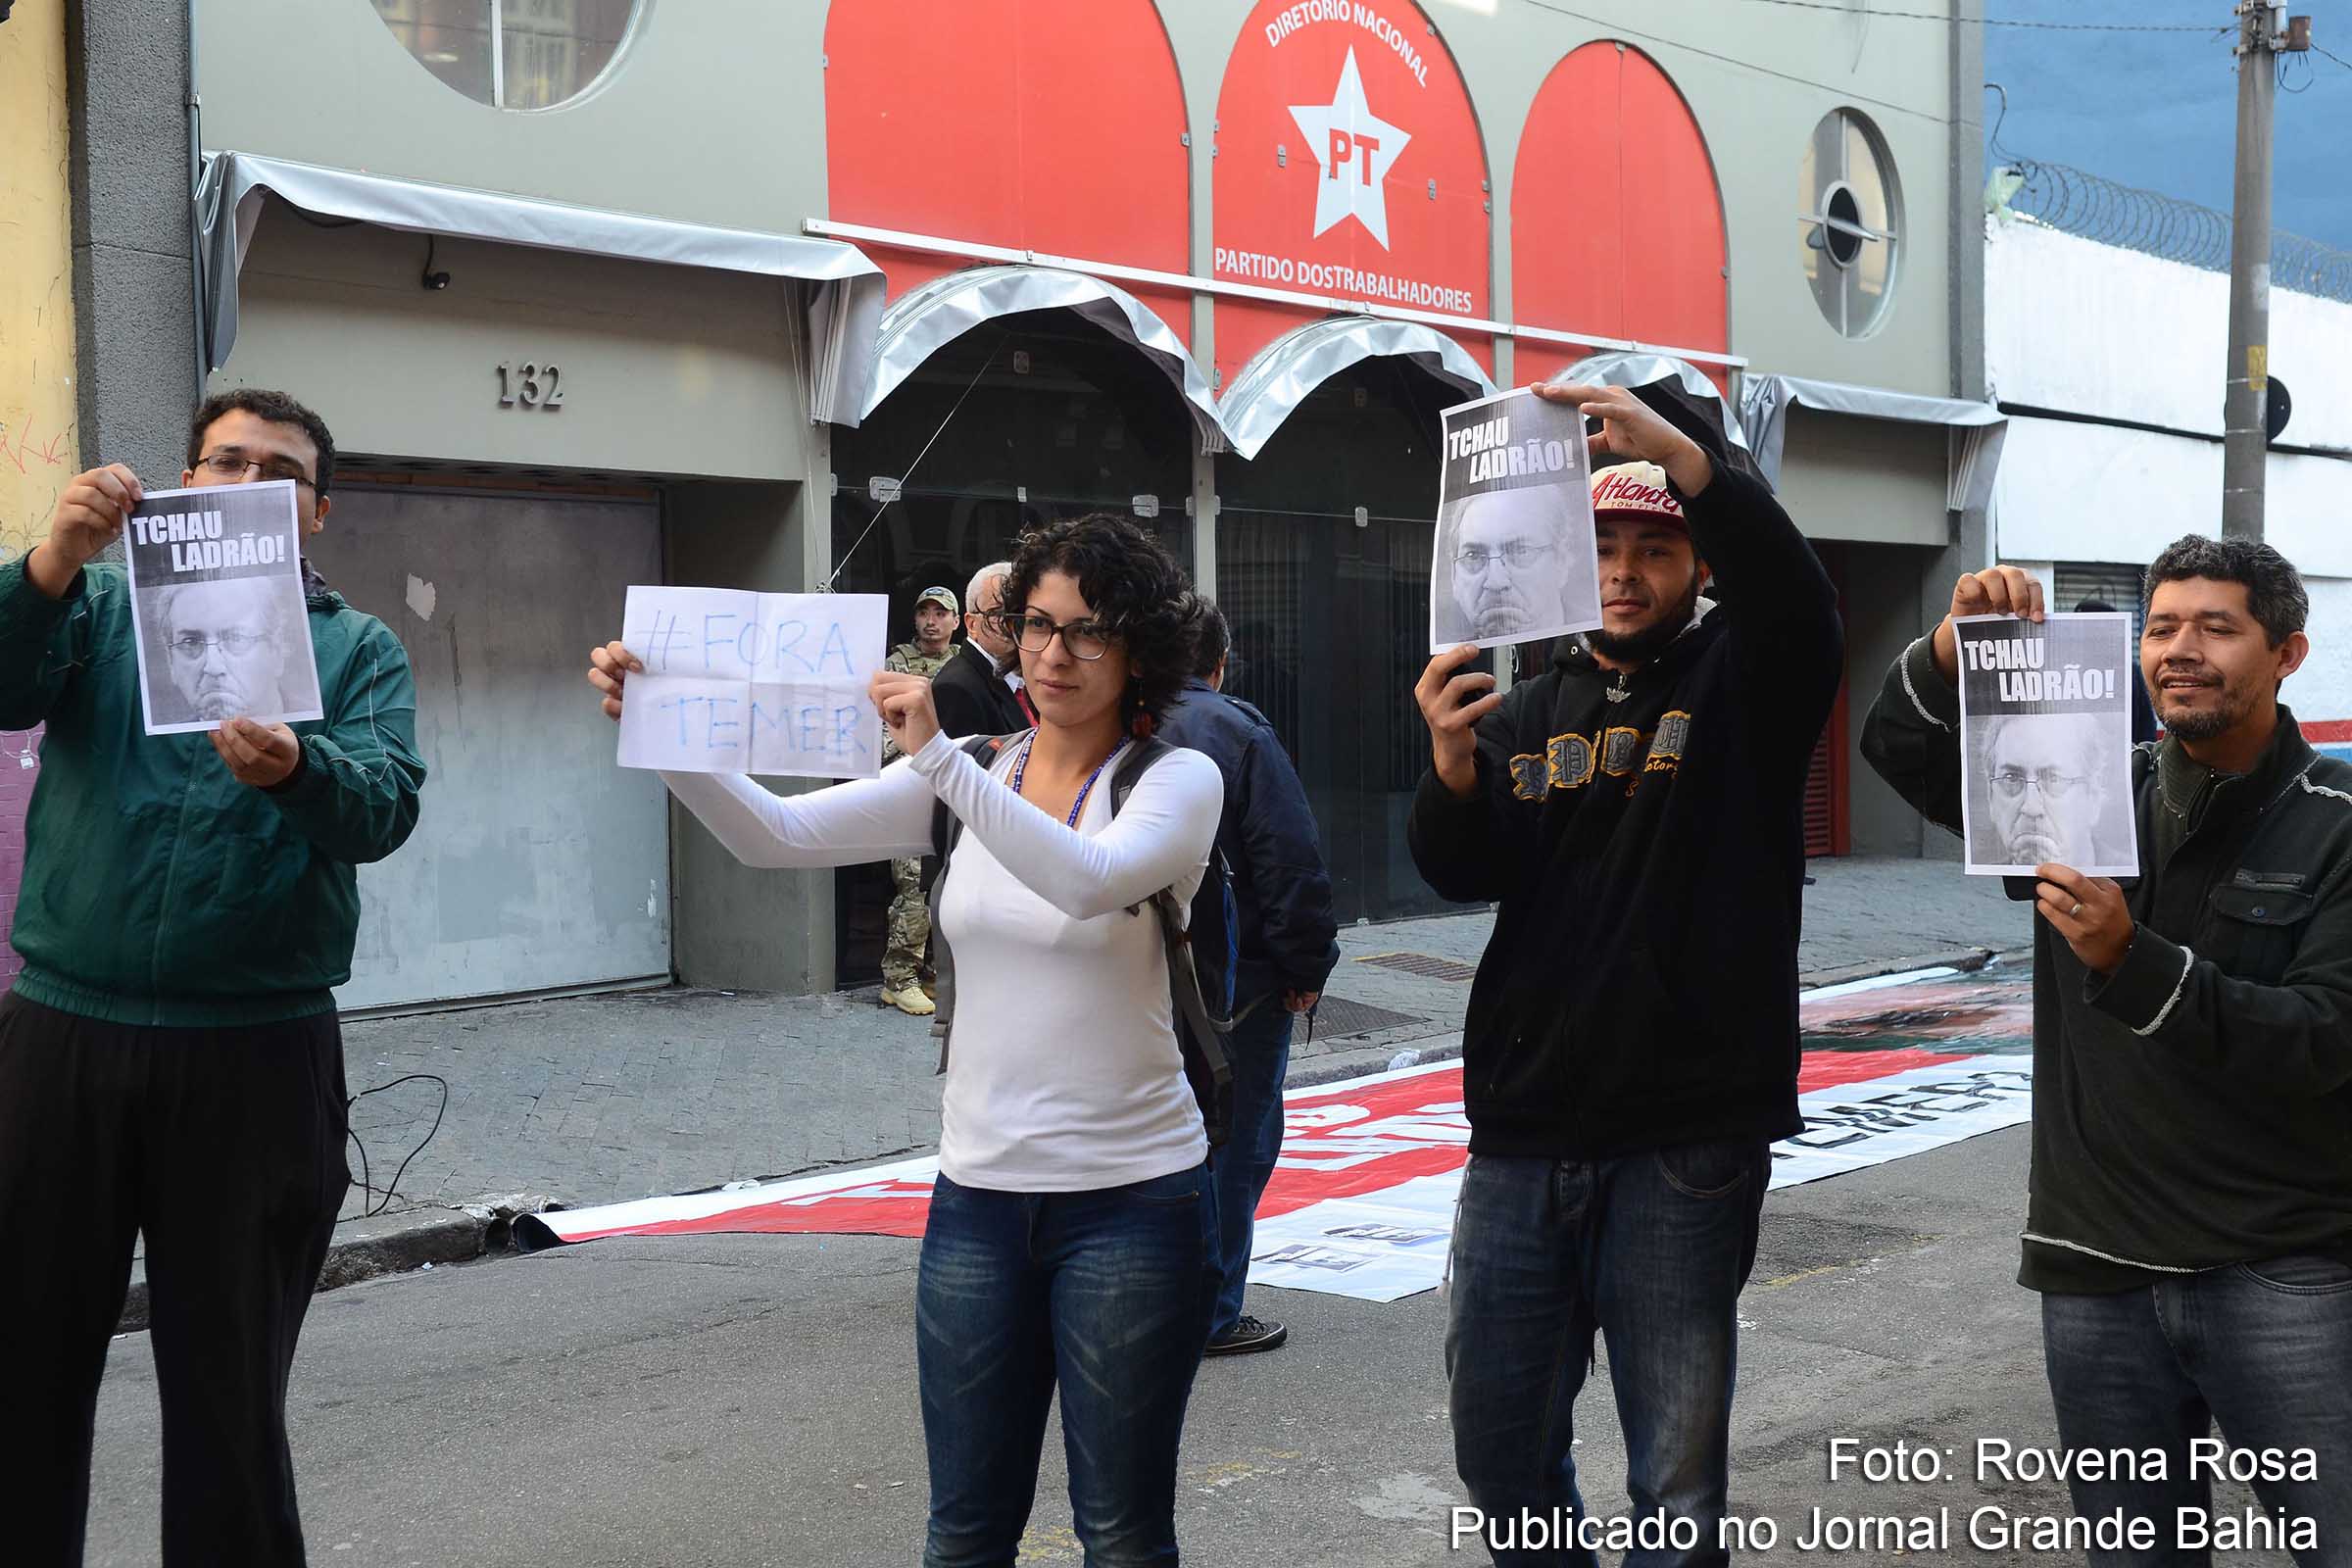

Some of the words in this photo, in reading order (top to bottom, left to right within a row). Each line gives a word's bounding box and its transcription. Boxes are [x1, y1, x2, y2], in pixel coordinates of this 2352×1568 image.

[1353, 2, 1428, 88] NACIONAL
[1329, 127, 1380, 187] PT
[1214, 247, 1295, 282] PARTIDO
[497, 360, 565, 409] 132
[1448, 416, 1510, 461] TCHAU
[1469, 437, 1575, 484] LADRÃO!
[131, 510, 223, 546] TCHAU
[171, 531, 285, 572] LADRÃO!
[634, 610, 855, 675] #FORA
[1964, 638, 2045, 670] TCHAU
[1998, 662, 2116, 702] LADRÃO!
[661, 696, 867, 756] TEMER
